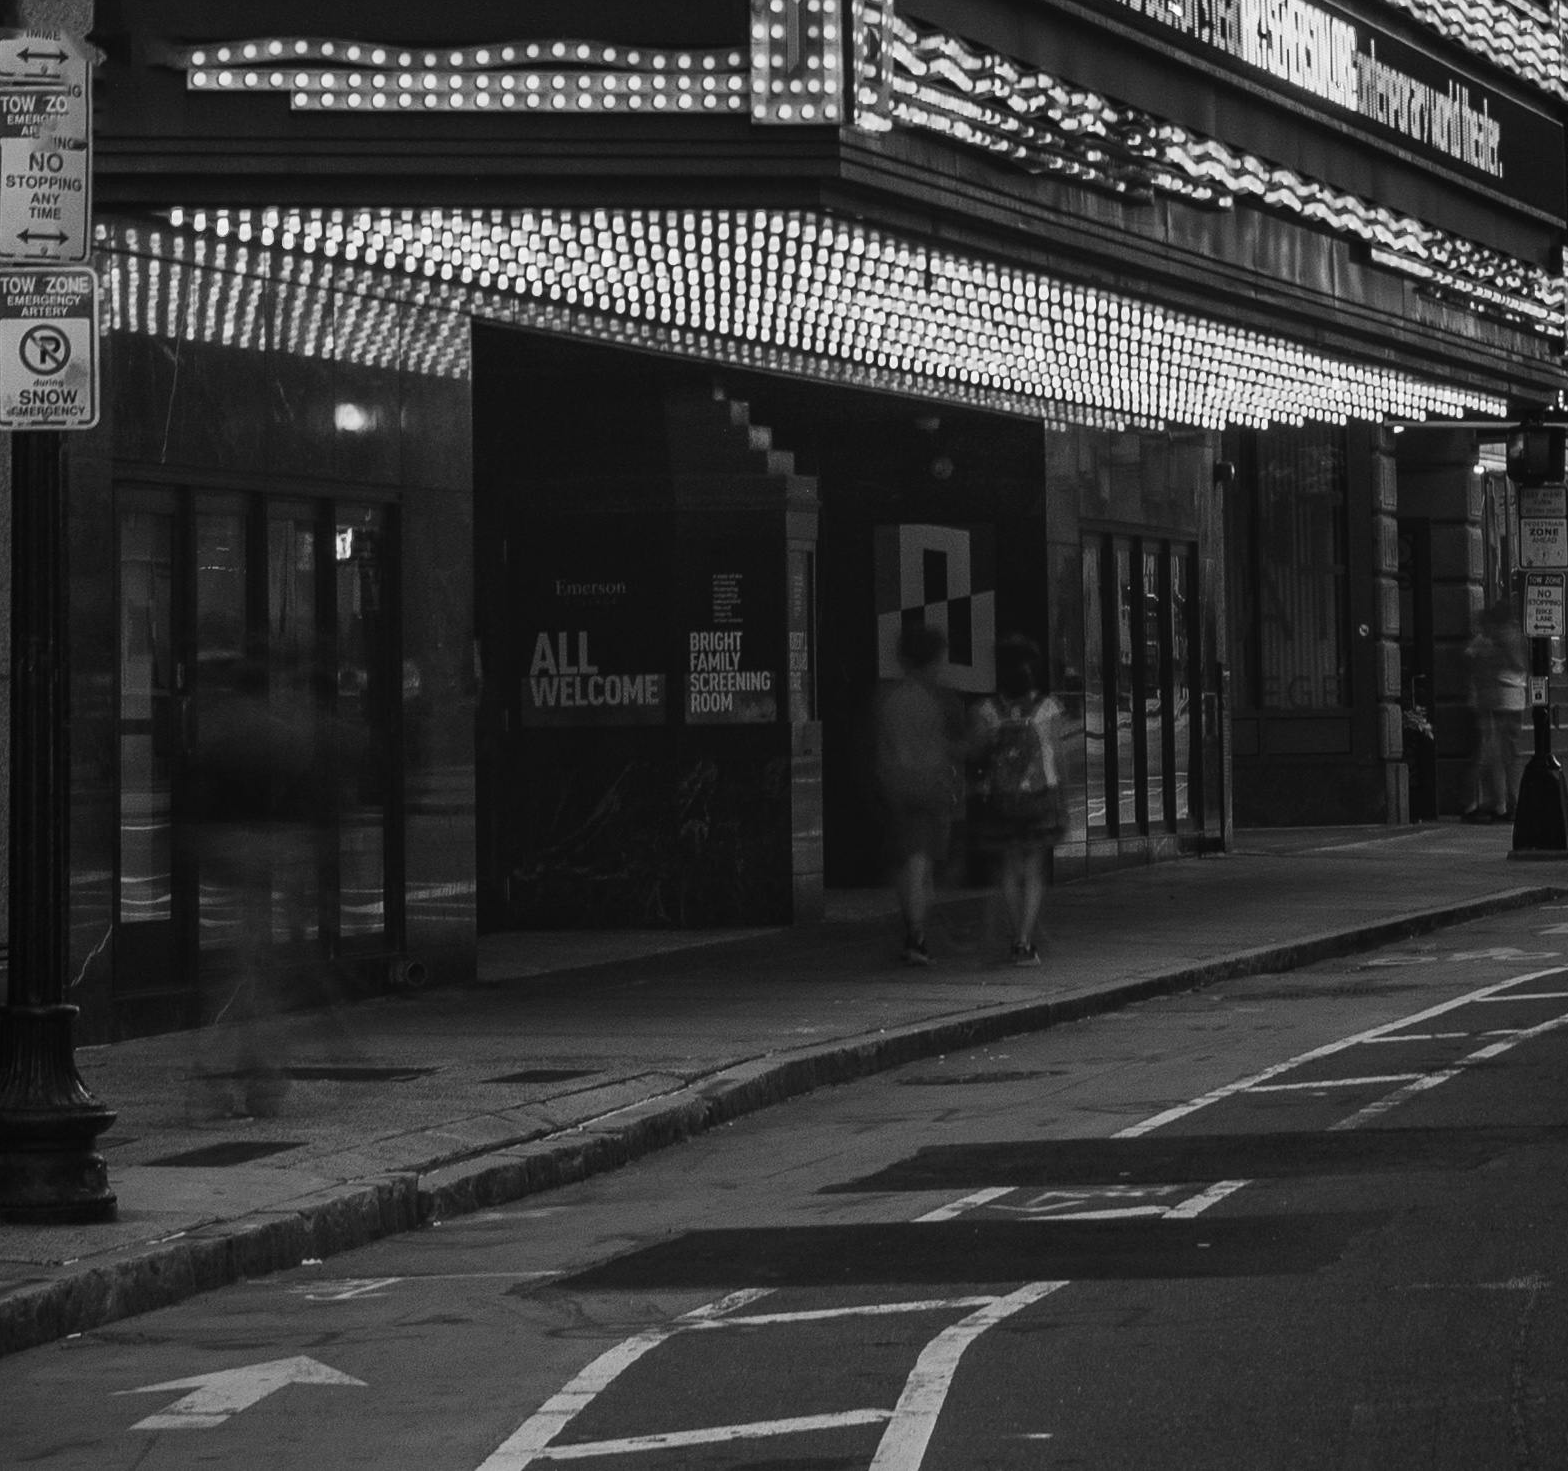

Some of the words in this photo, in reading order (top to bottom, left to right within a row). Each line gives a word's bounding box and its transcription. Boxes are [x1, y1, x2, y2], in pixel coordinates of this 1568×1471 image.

[42, 95, 68, 113] ZO
[29, 152, 63, 174] NO
[5, 174, 82, 192] STOPPING
[30, 193, 60, 205] ANY
[29, 206, 62, 220] TIME
[45, 276, 90, 294] ZONE
[6, 295, 81, 307] EMERGENCY
[20, 305, 69, 318] ARTERY
[33, 378, 65, 387] during
[19, 389, 78, 405] SNOW
[1530, 528, 1559, 536] ZONE
[554, 580, 628, 597] Emerson
[1537, 590, 1552, 598] NO
[689, 631, 743, 652] BRIGHT
[529, 630, 599, 676] ALL
[689, 651, 742, 672] FAMILY
[530, 674, 661, 708] WELCOME
[689, 671, 772, 693] SCREENING
[690, 692, 733, 714] ROOM
